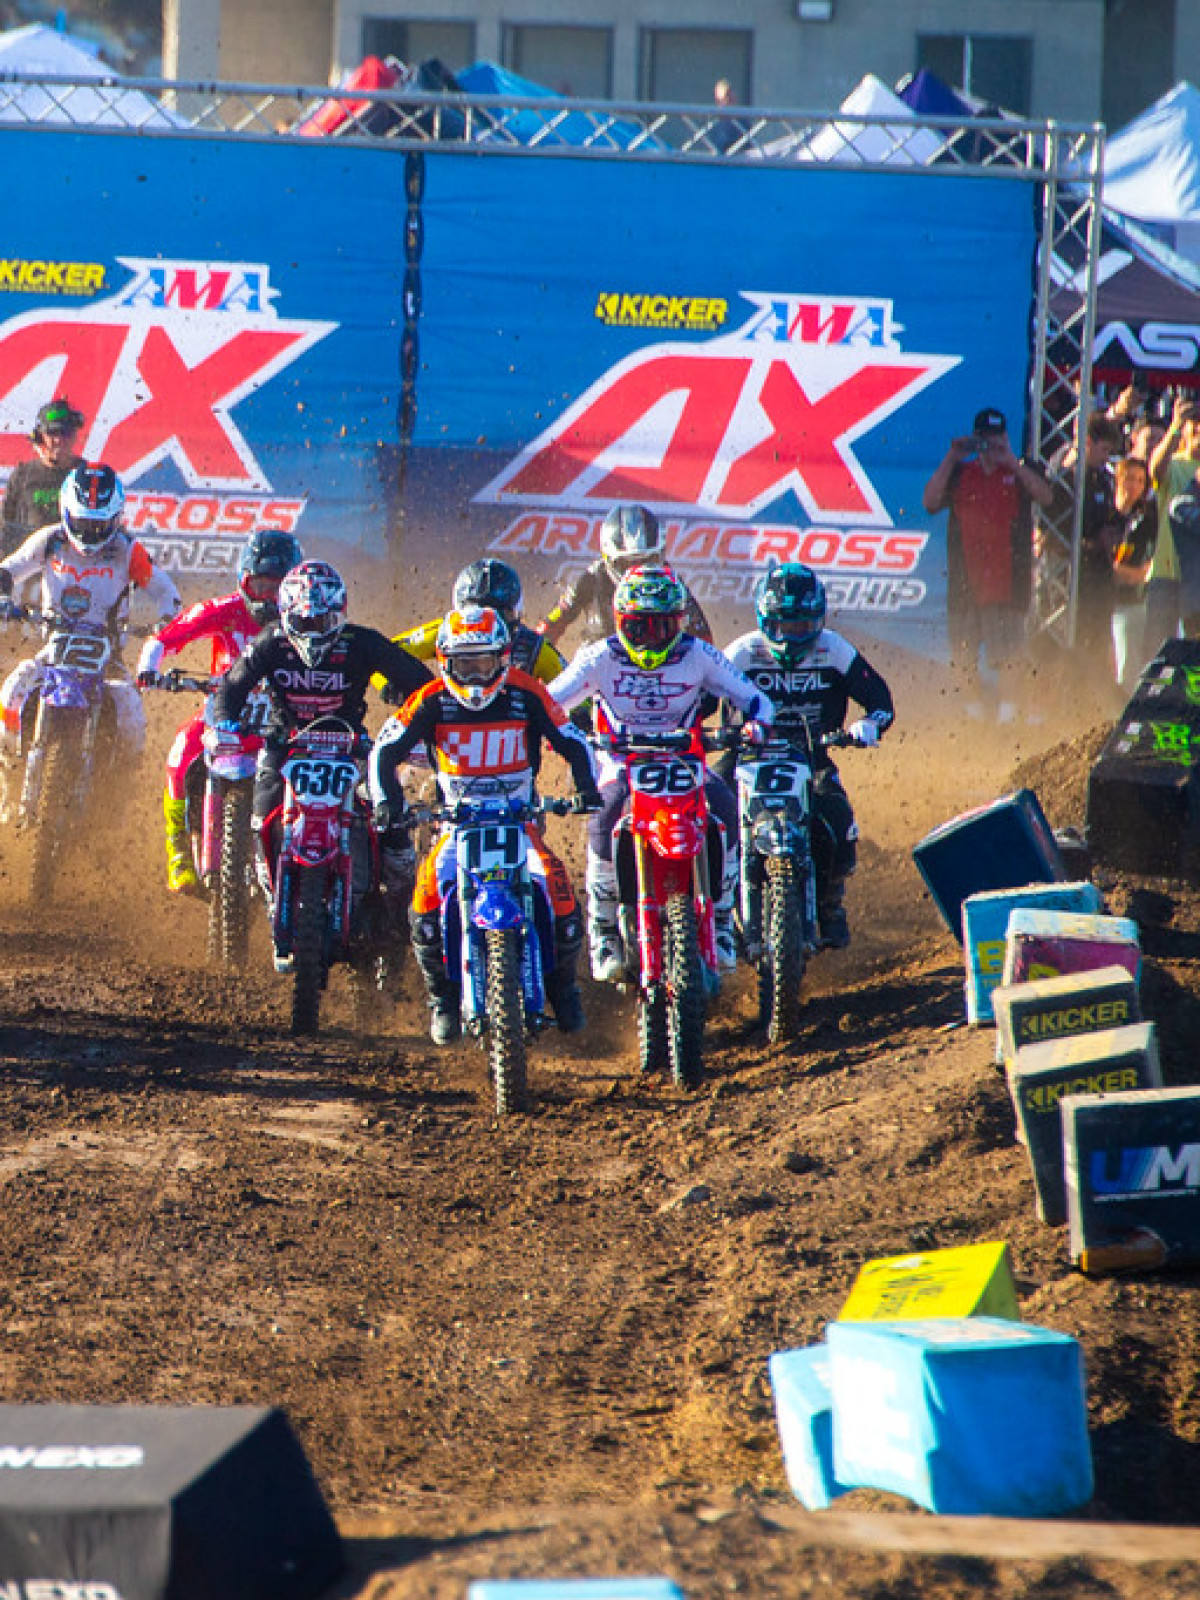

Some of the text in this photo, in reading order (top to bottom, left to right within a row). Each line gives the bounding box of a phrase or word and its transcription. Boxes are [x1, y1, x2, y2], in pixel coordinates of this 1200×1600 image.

[120, 268, 268, 312] AMA
[618, 293, 728, 323] KICKER
[746, 301, 885, 346] AMA
[1092, 321, 1200, 370] AS
[499, 355, 931, 514] AX
[290, 762, 355, 797] 636
[755, 764, 798, 793] 6
[463, 827, 519, 869] 14
[1041, 1001, 1128, 1032] KICKER
[1047, 1068, 1139, 1104] KICKER
